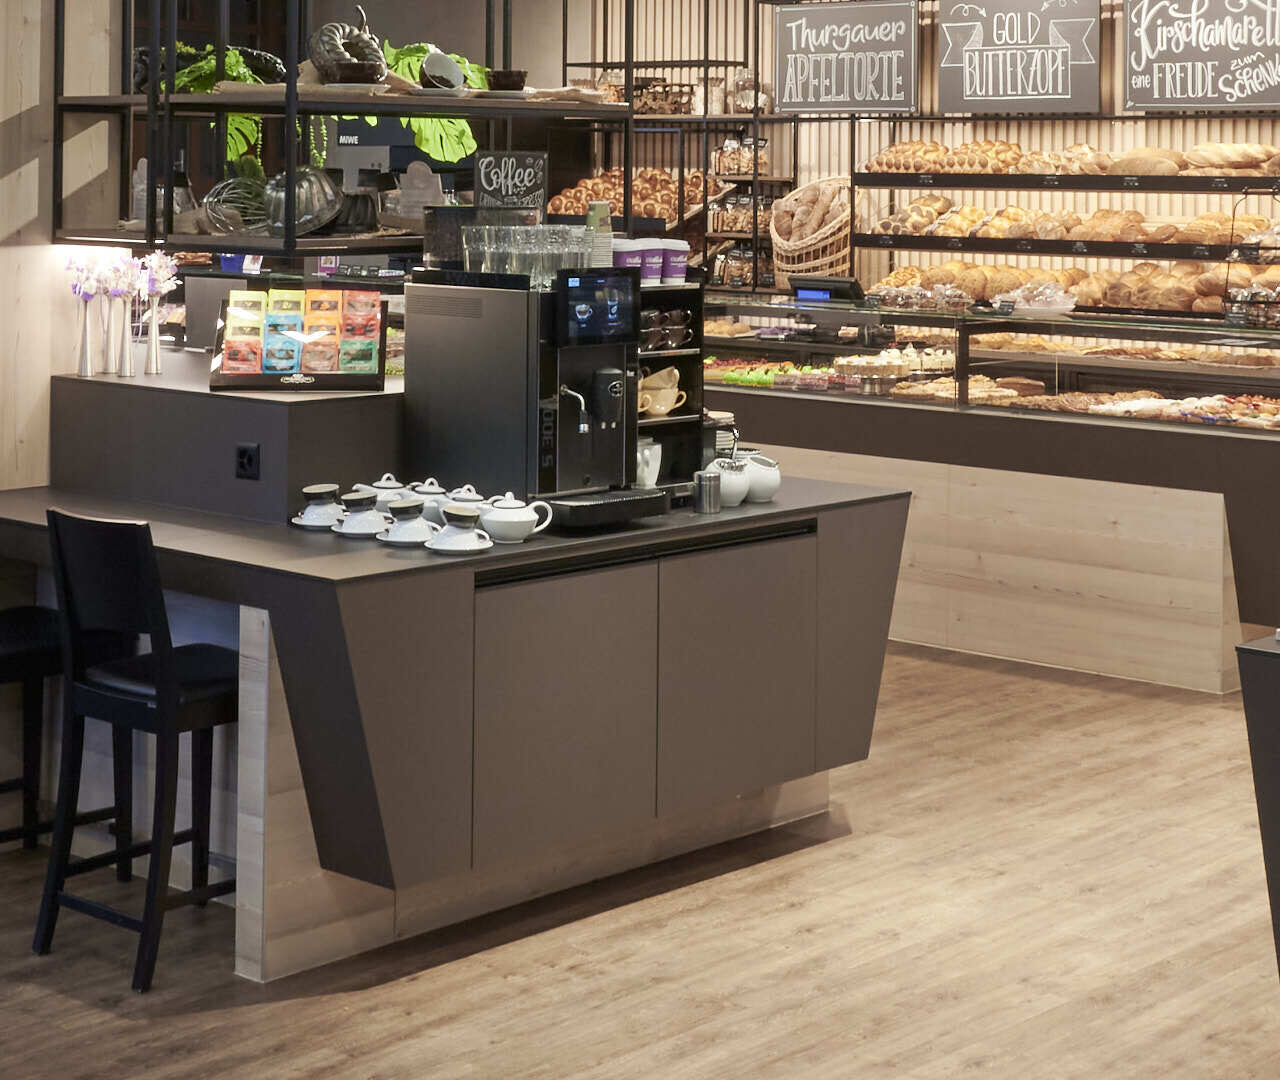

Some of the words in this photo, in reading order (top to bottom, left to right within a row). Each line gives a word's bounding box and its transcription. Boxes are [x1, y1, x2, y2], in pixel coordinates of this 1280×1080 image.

[785, 17, 906, 52] Thurgauer
[993, 12, 1040, 44] GOLD
[782, 50, 905, 103] APFELTORTE
[965, 49, 1068, 96] BUTTERZOPF
[1230, 51, 1265, 71] zum
[1131, 74, 1151, 89] eine
[1153, 61, 1219, 99] FREUDE
[339, 135, 359, 145] MIWE
[479, 156, 536, 195] Coffee
